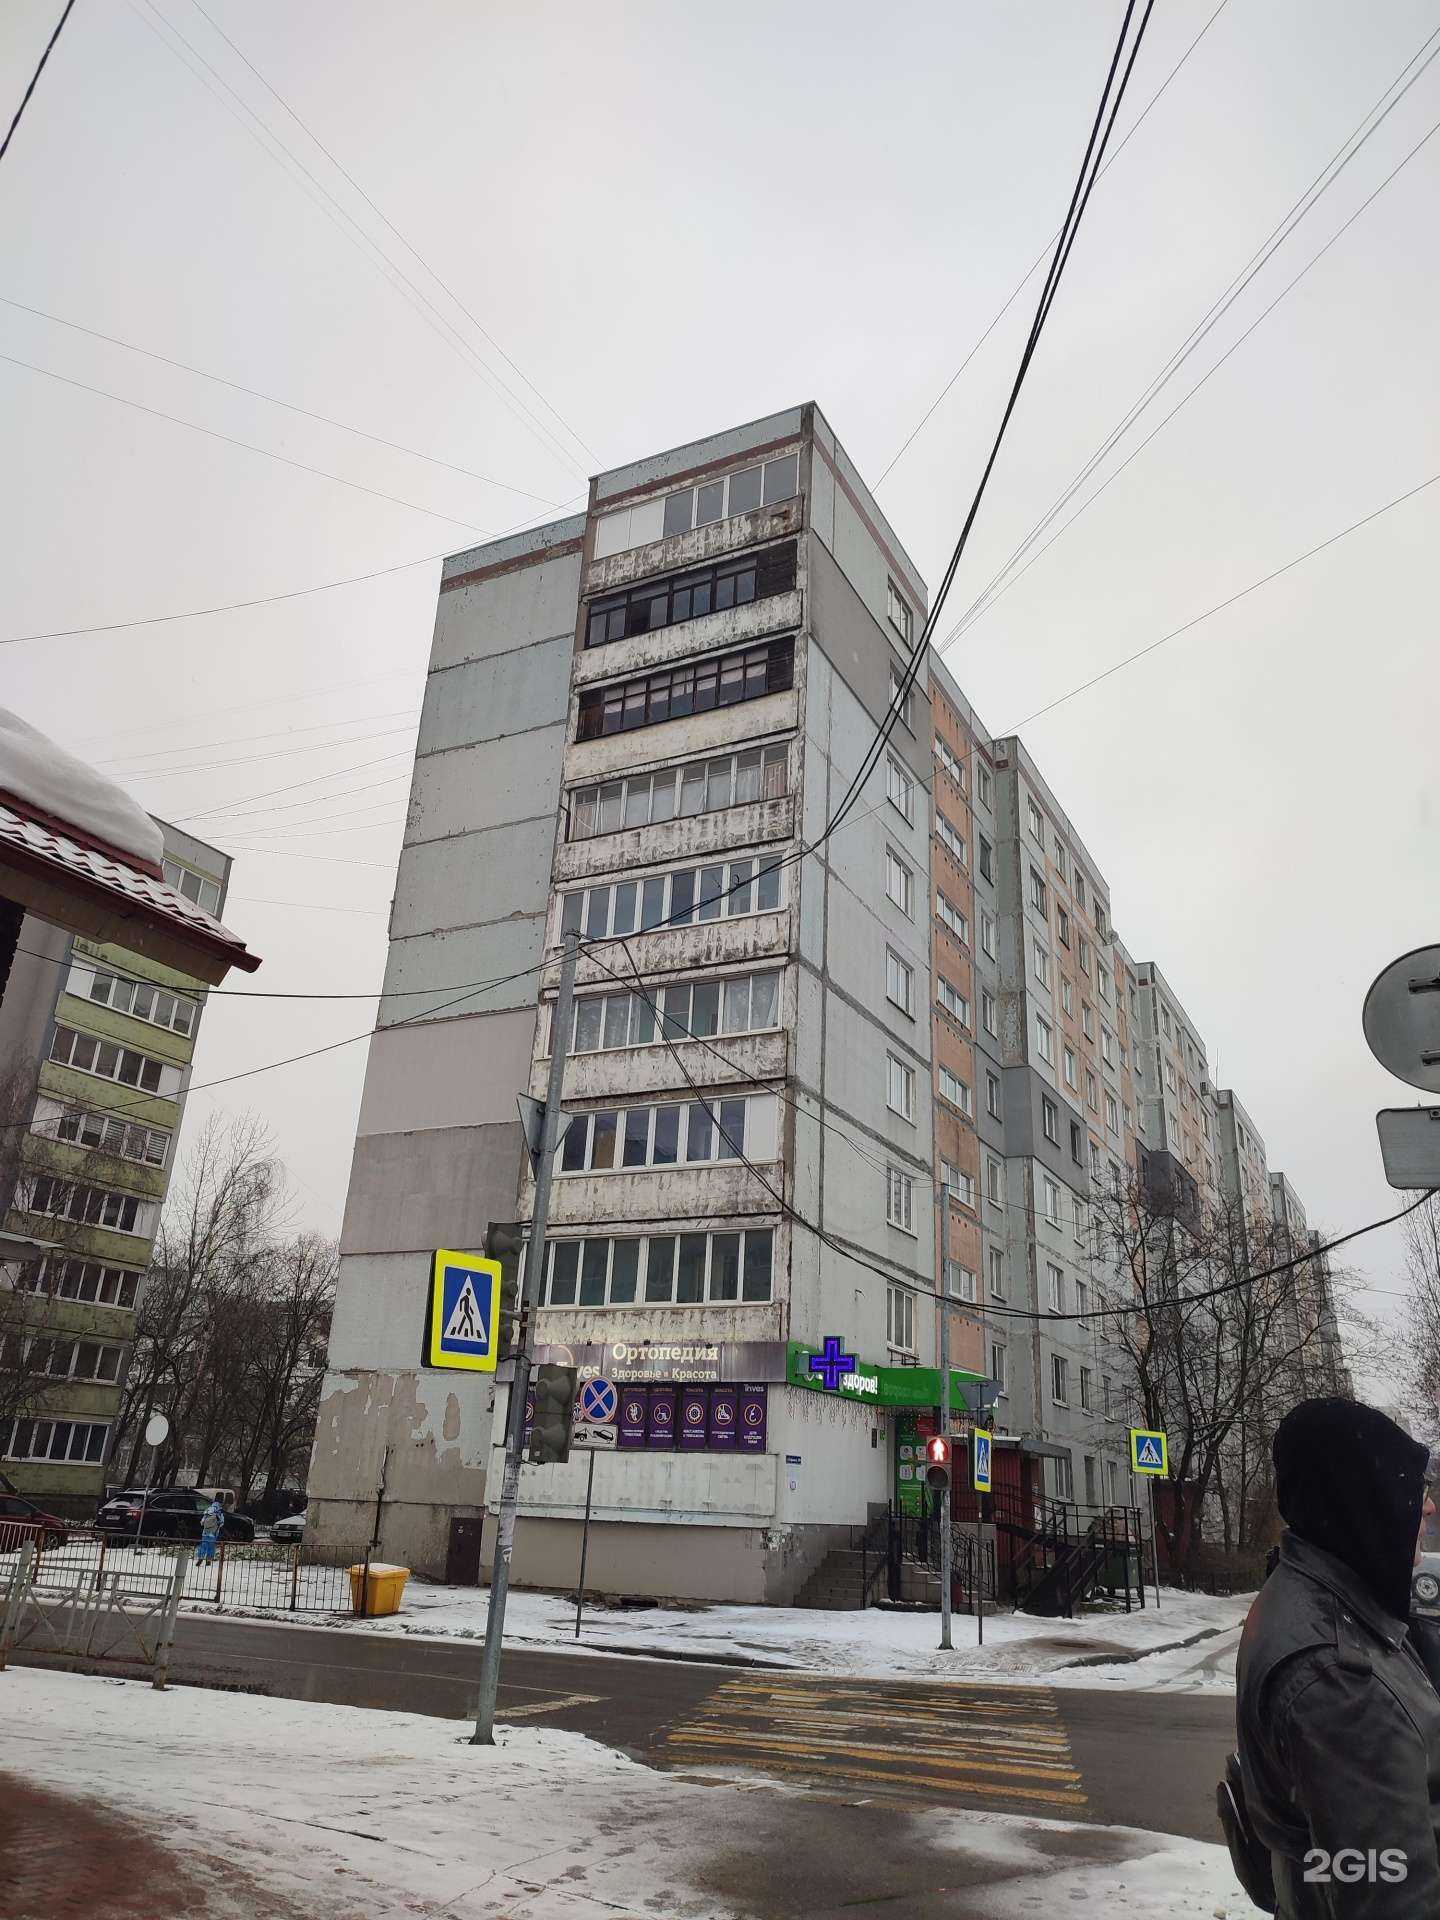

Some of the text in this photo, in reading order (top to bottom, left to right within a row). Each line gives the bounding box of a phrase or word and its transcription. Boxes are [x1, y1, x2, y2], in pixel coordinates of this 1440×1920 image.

[612, 1343, 719, 1365] Ортопедия
[611, 1367, 661, 1380] Здоровье
[671, 1367, 717, 1380] Красота
[843, 1374, 878, 1395] здоров!
